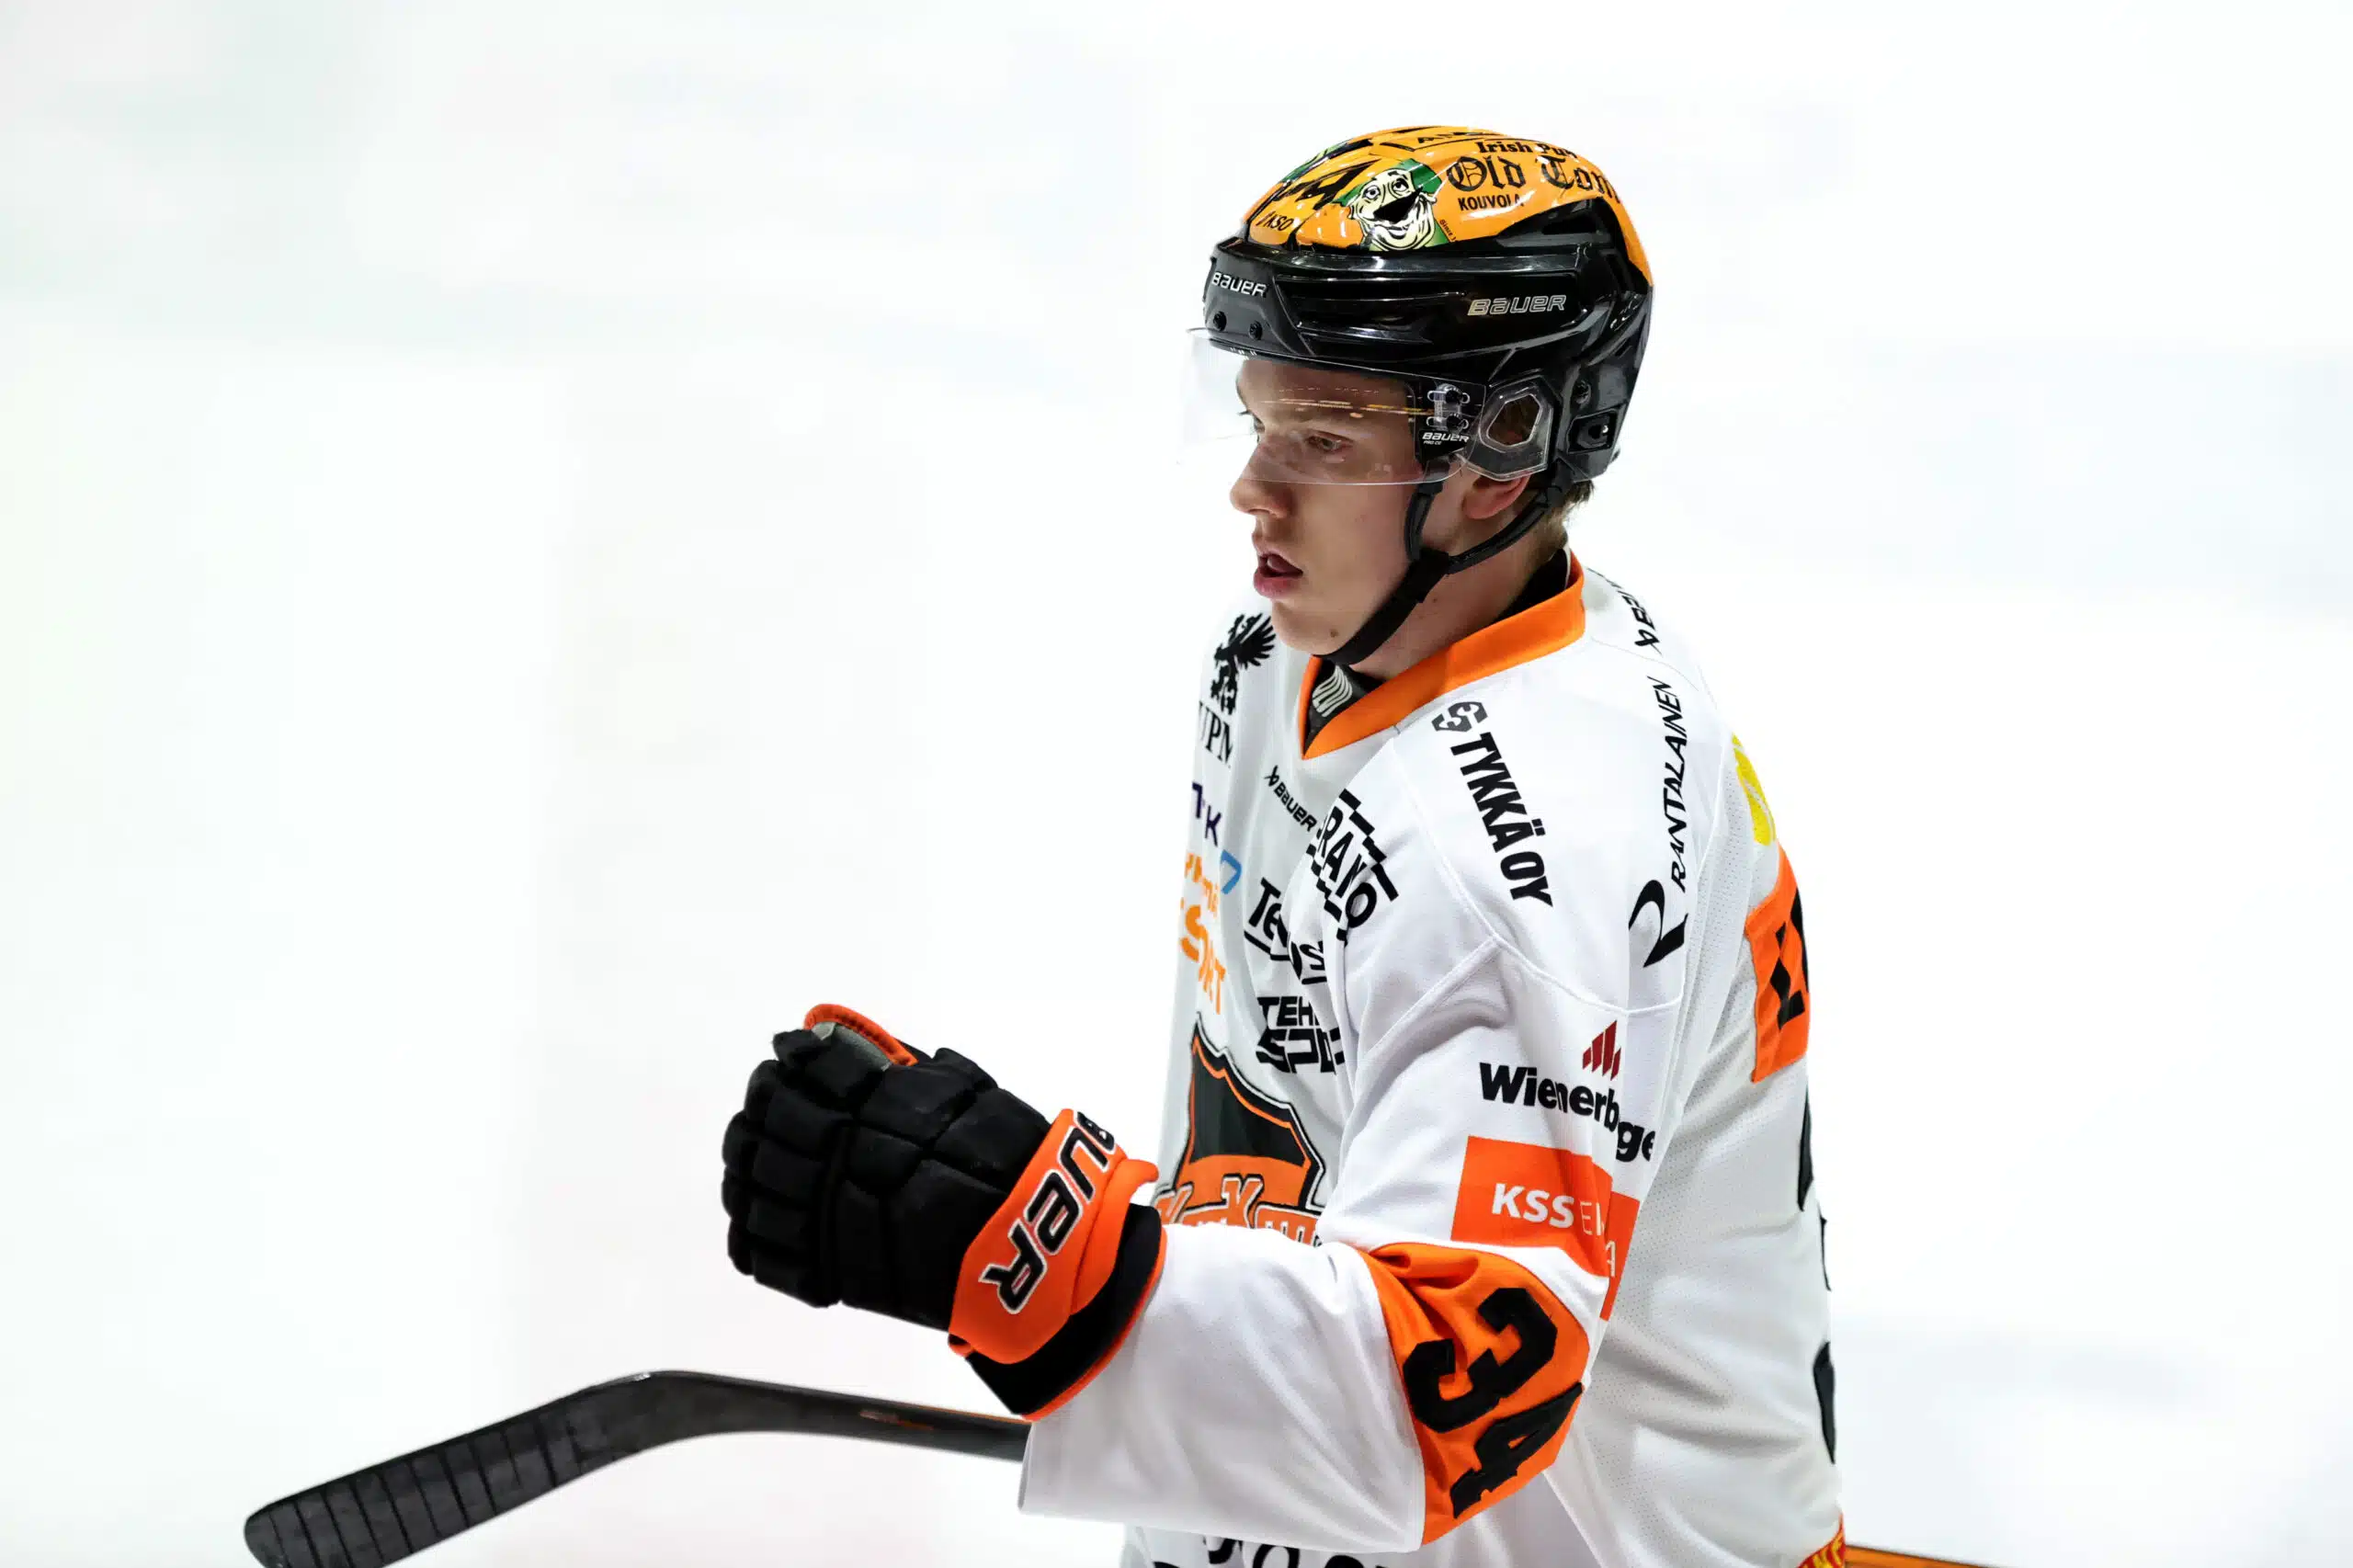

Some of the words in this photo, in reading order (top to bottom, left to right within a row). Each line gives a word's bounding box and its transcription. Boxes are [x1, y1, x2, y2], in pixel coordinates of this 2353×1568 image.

[1475, 141, 1534, 153] Irish
[1446, 154, 1527, 191] Old
[1211, 272, 1267, 297] BAUER
[1467, 294, 1567, 316] BAUER
[1422, 432, 1470, 442] BAUER
[1647, 676, 1688, 893] RANTALAINEN
[1274, 784, 1318, 832] BAUER
[1449, 732, 1546, 853] TYKKÄ
[1499, 851, 1553, 907] OY
[1491, 1182, 1575, 1229] KSS
[1403, 1287, 1586, 1519] 34
